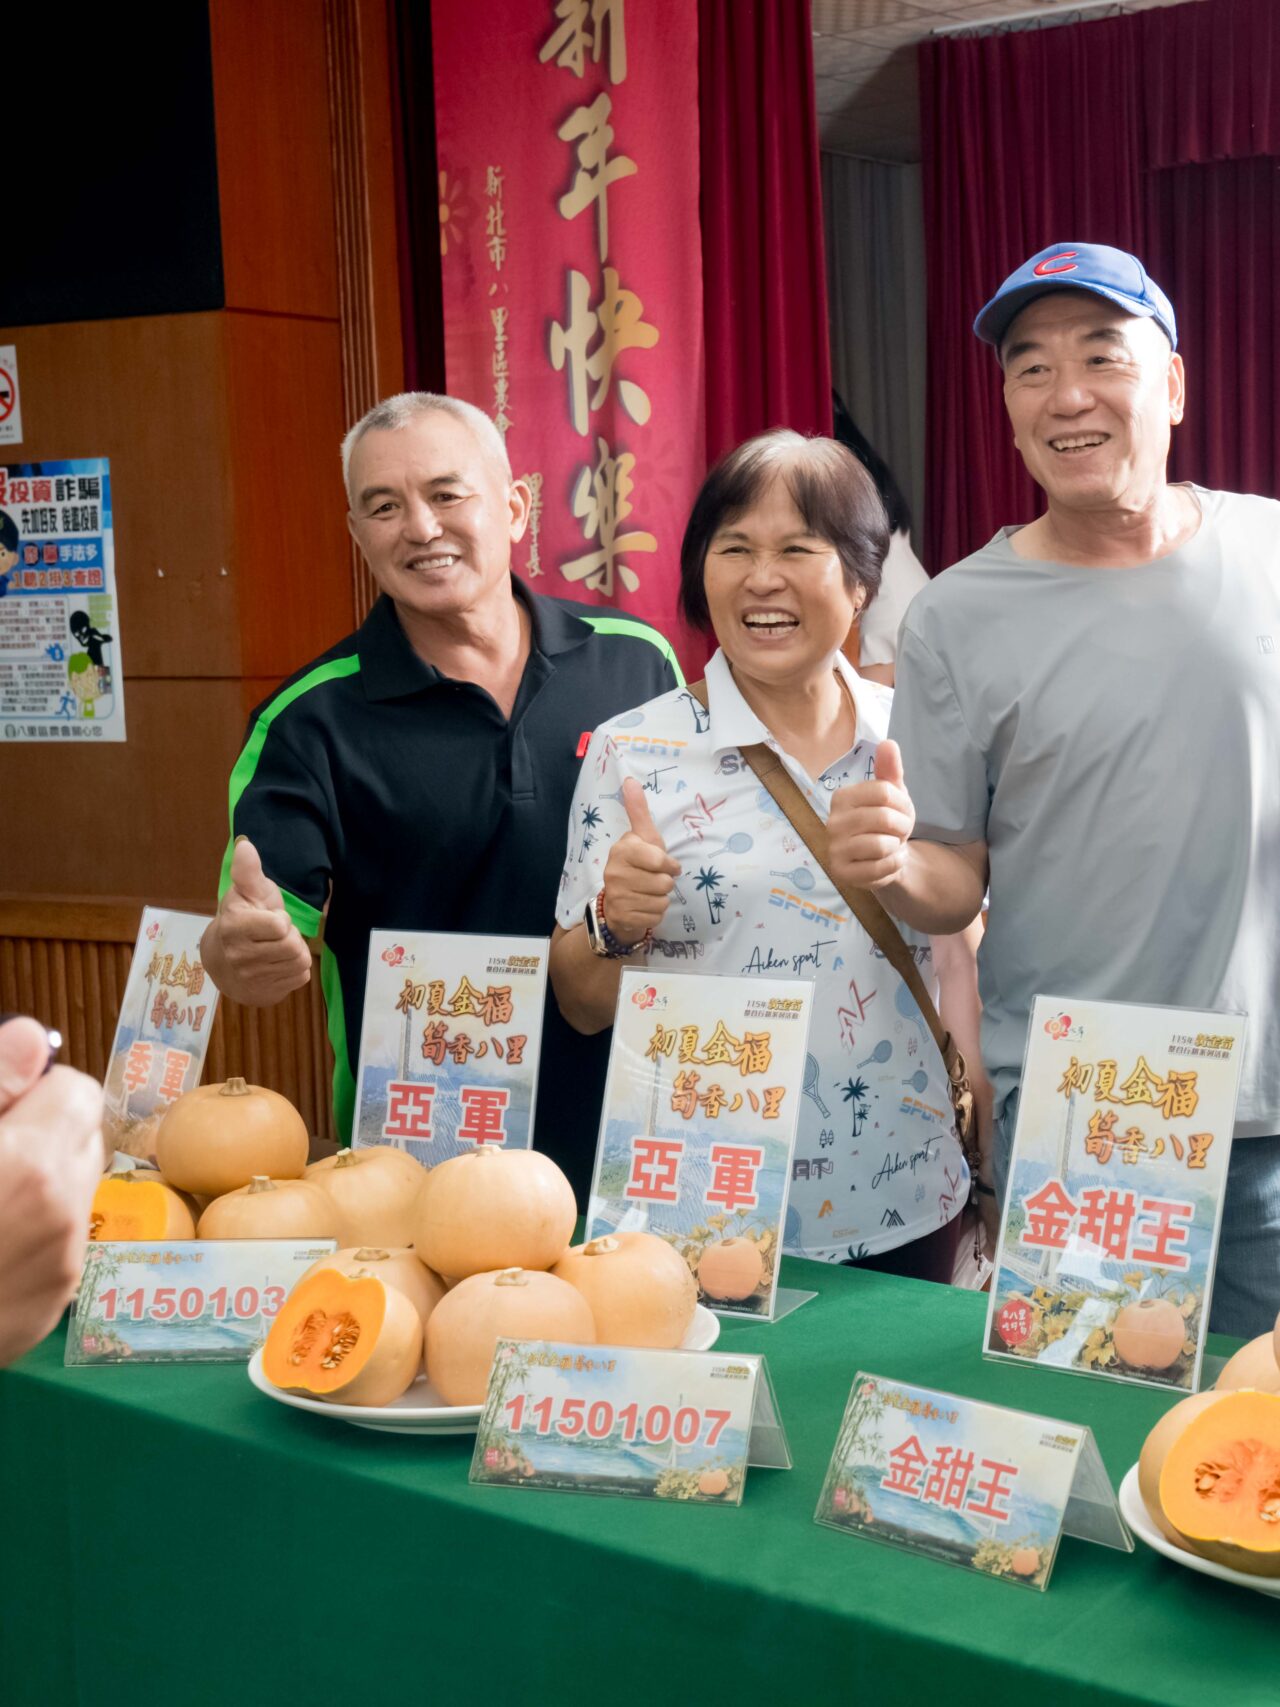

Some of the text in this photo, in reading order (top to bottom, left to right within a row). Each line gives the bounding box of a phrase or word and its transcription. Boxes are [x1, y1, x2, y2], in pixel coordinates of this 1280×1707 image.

[1032, 251, 1079, 277] C
[395, 976, 514, 1027] 初夏金福
[421, 1020, 528, 1066] 筍香八里
[645, 1020, 773, 1077] 初夏金福
[385, 1083, 508, 1145] 亞軍
[671, 1070, 787, 1120] 筍香八里
[1057, 1055, 1199, 1121] 初夏金福
[1085, 1109, 1215, 1170] 筍香八里
[626, 1139, 762, 1210] 亞軍
[1021, 1180, 1194, 1269] 金甜王
[505, 1394, 731, 1446] 11501007
[882, 1434, 1019, 1521] 金甜王
